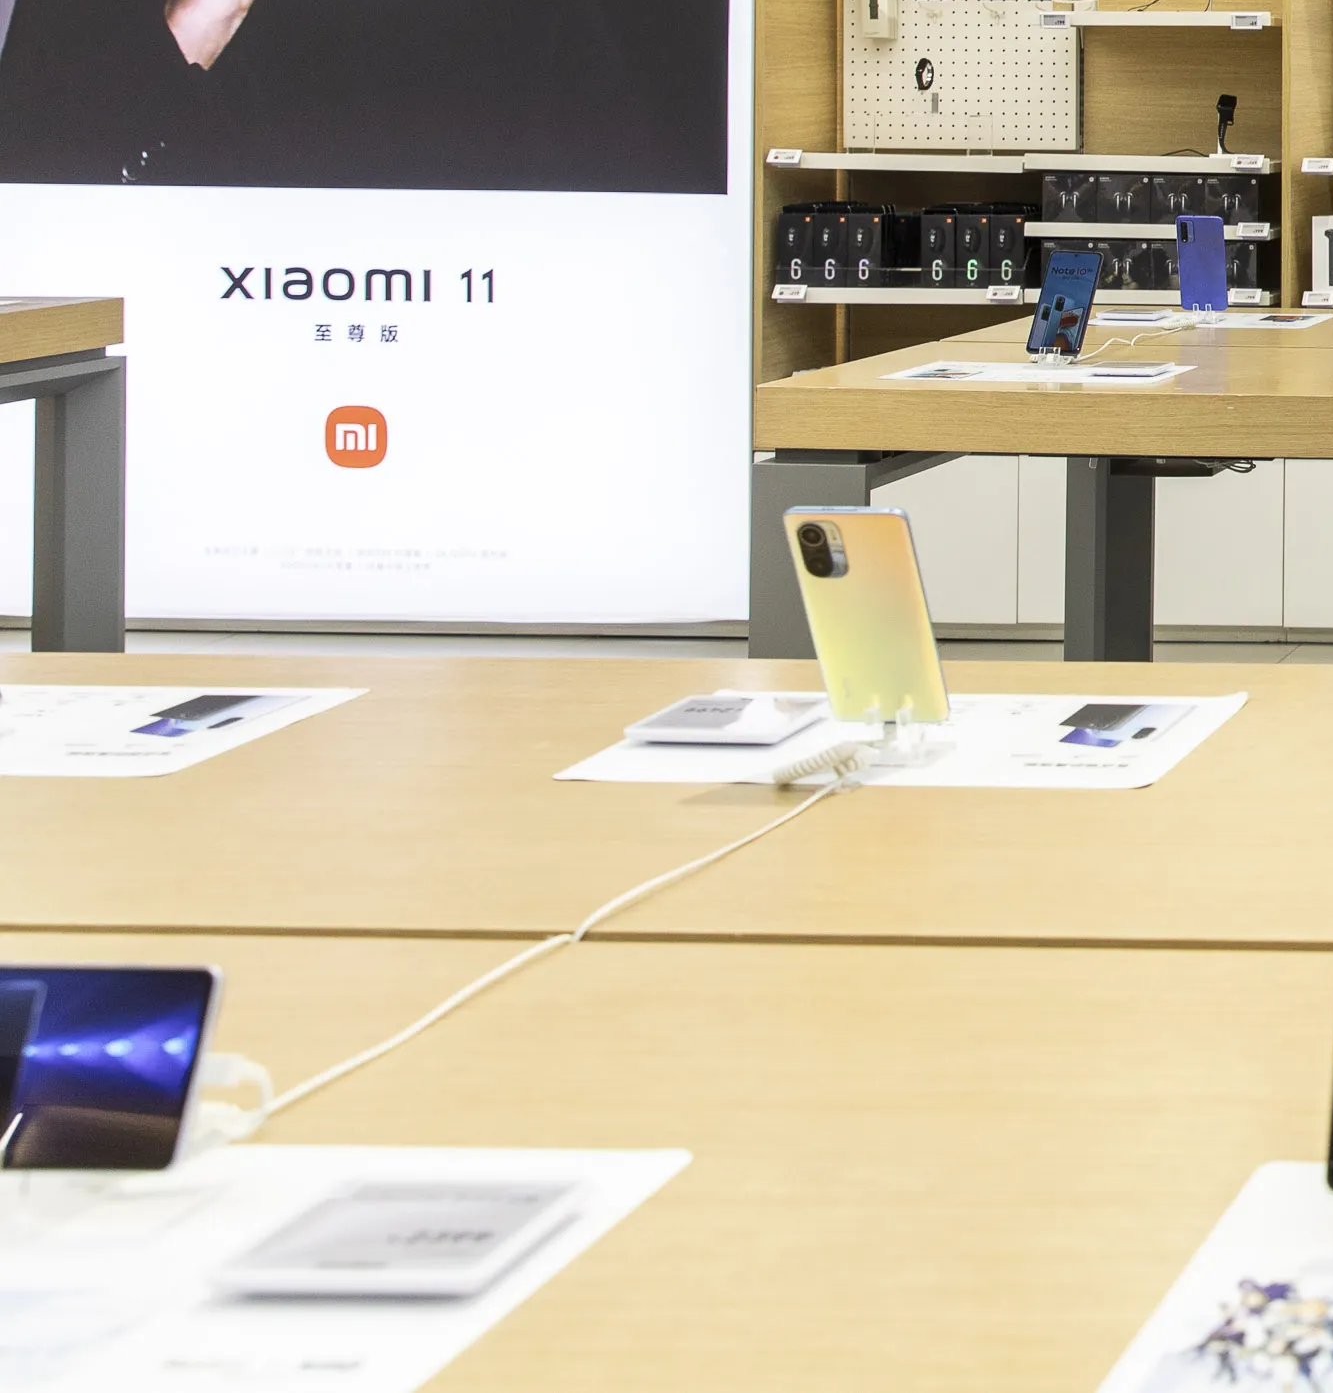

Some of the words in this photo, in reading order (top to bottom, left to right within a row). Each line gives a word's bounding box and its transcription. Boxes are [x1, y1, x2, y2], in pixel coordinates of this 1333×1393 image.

[790, 259, 802, 279] 6
[824, 259, 836, 279] 6
[858, 259, 870, 279] 6
[931, 260, 943, 280] 6
[966, 260, 978, 280] 6
[1001, 260, 1013, 280] 6
[460, 268, 495, 304] 11
[313, 323, 399, 344] 至尊版
